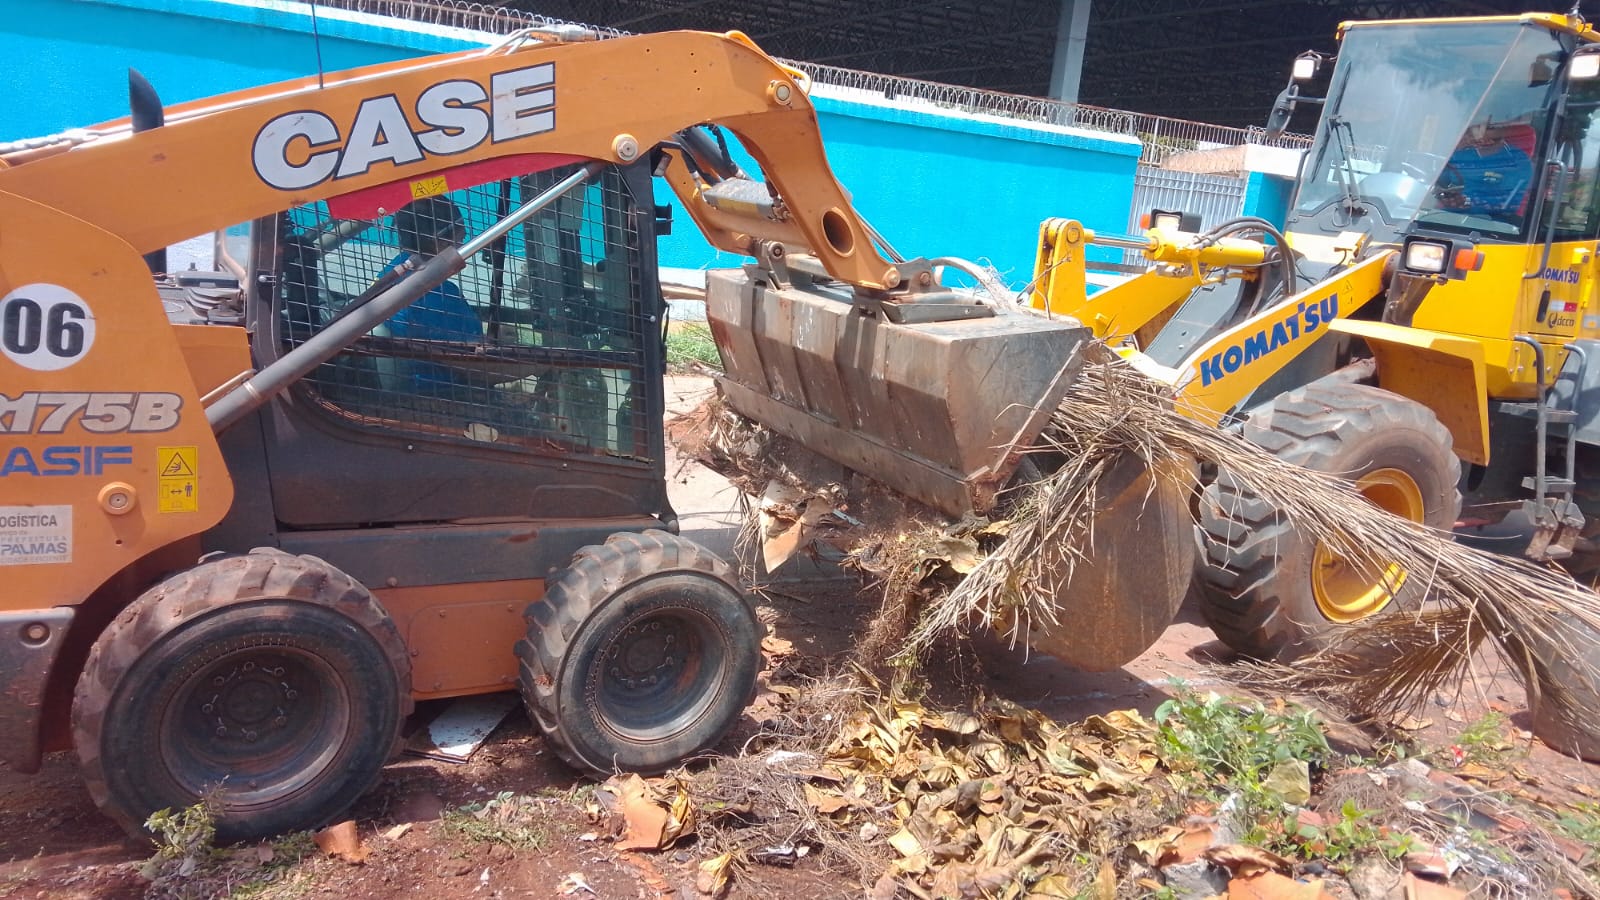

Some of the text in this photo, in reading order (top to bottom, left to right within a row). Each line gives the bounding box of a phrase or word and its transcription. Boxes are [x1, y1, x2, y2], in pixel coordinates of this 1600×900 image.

[252, 61, 556, 191] CASE
[1539, 267, 1580, 284] OMATSU
[2, 298, 86, 358] 06
[1200, 293, 1339, 387] KOMATSU
[0, 446, 132, 476] ASIF
[1, 542, 67, 555] PALMAS
